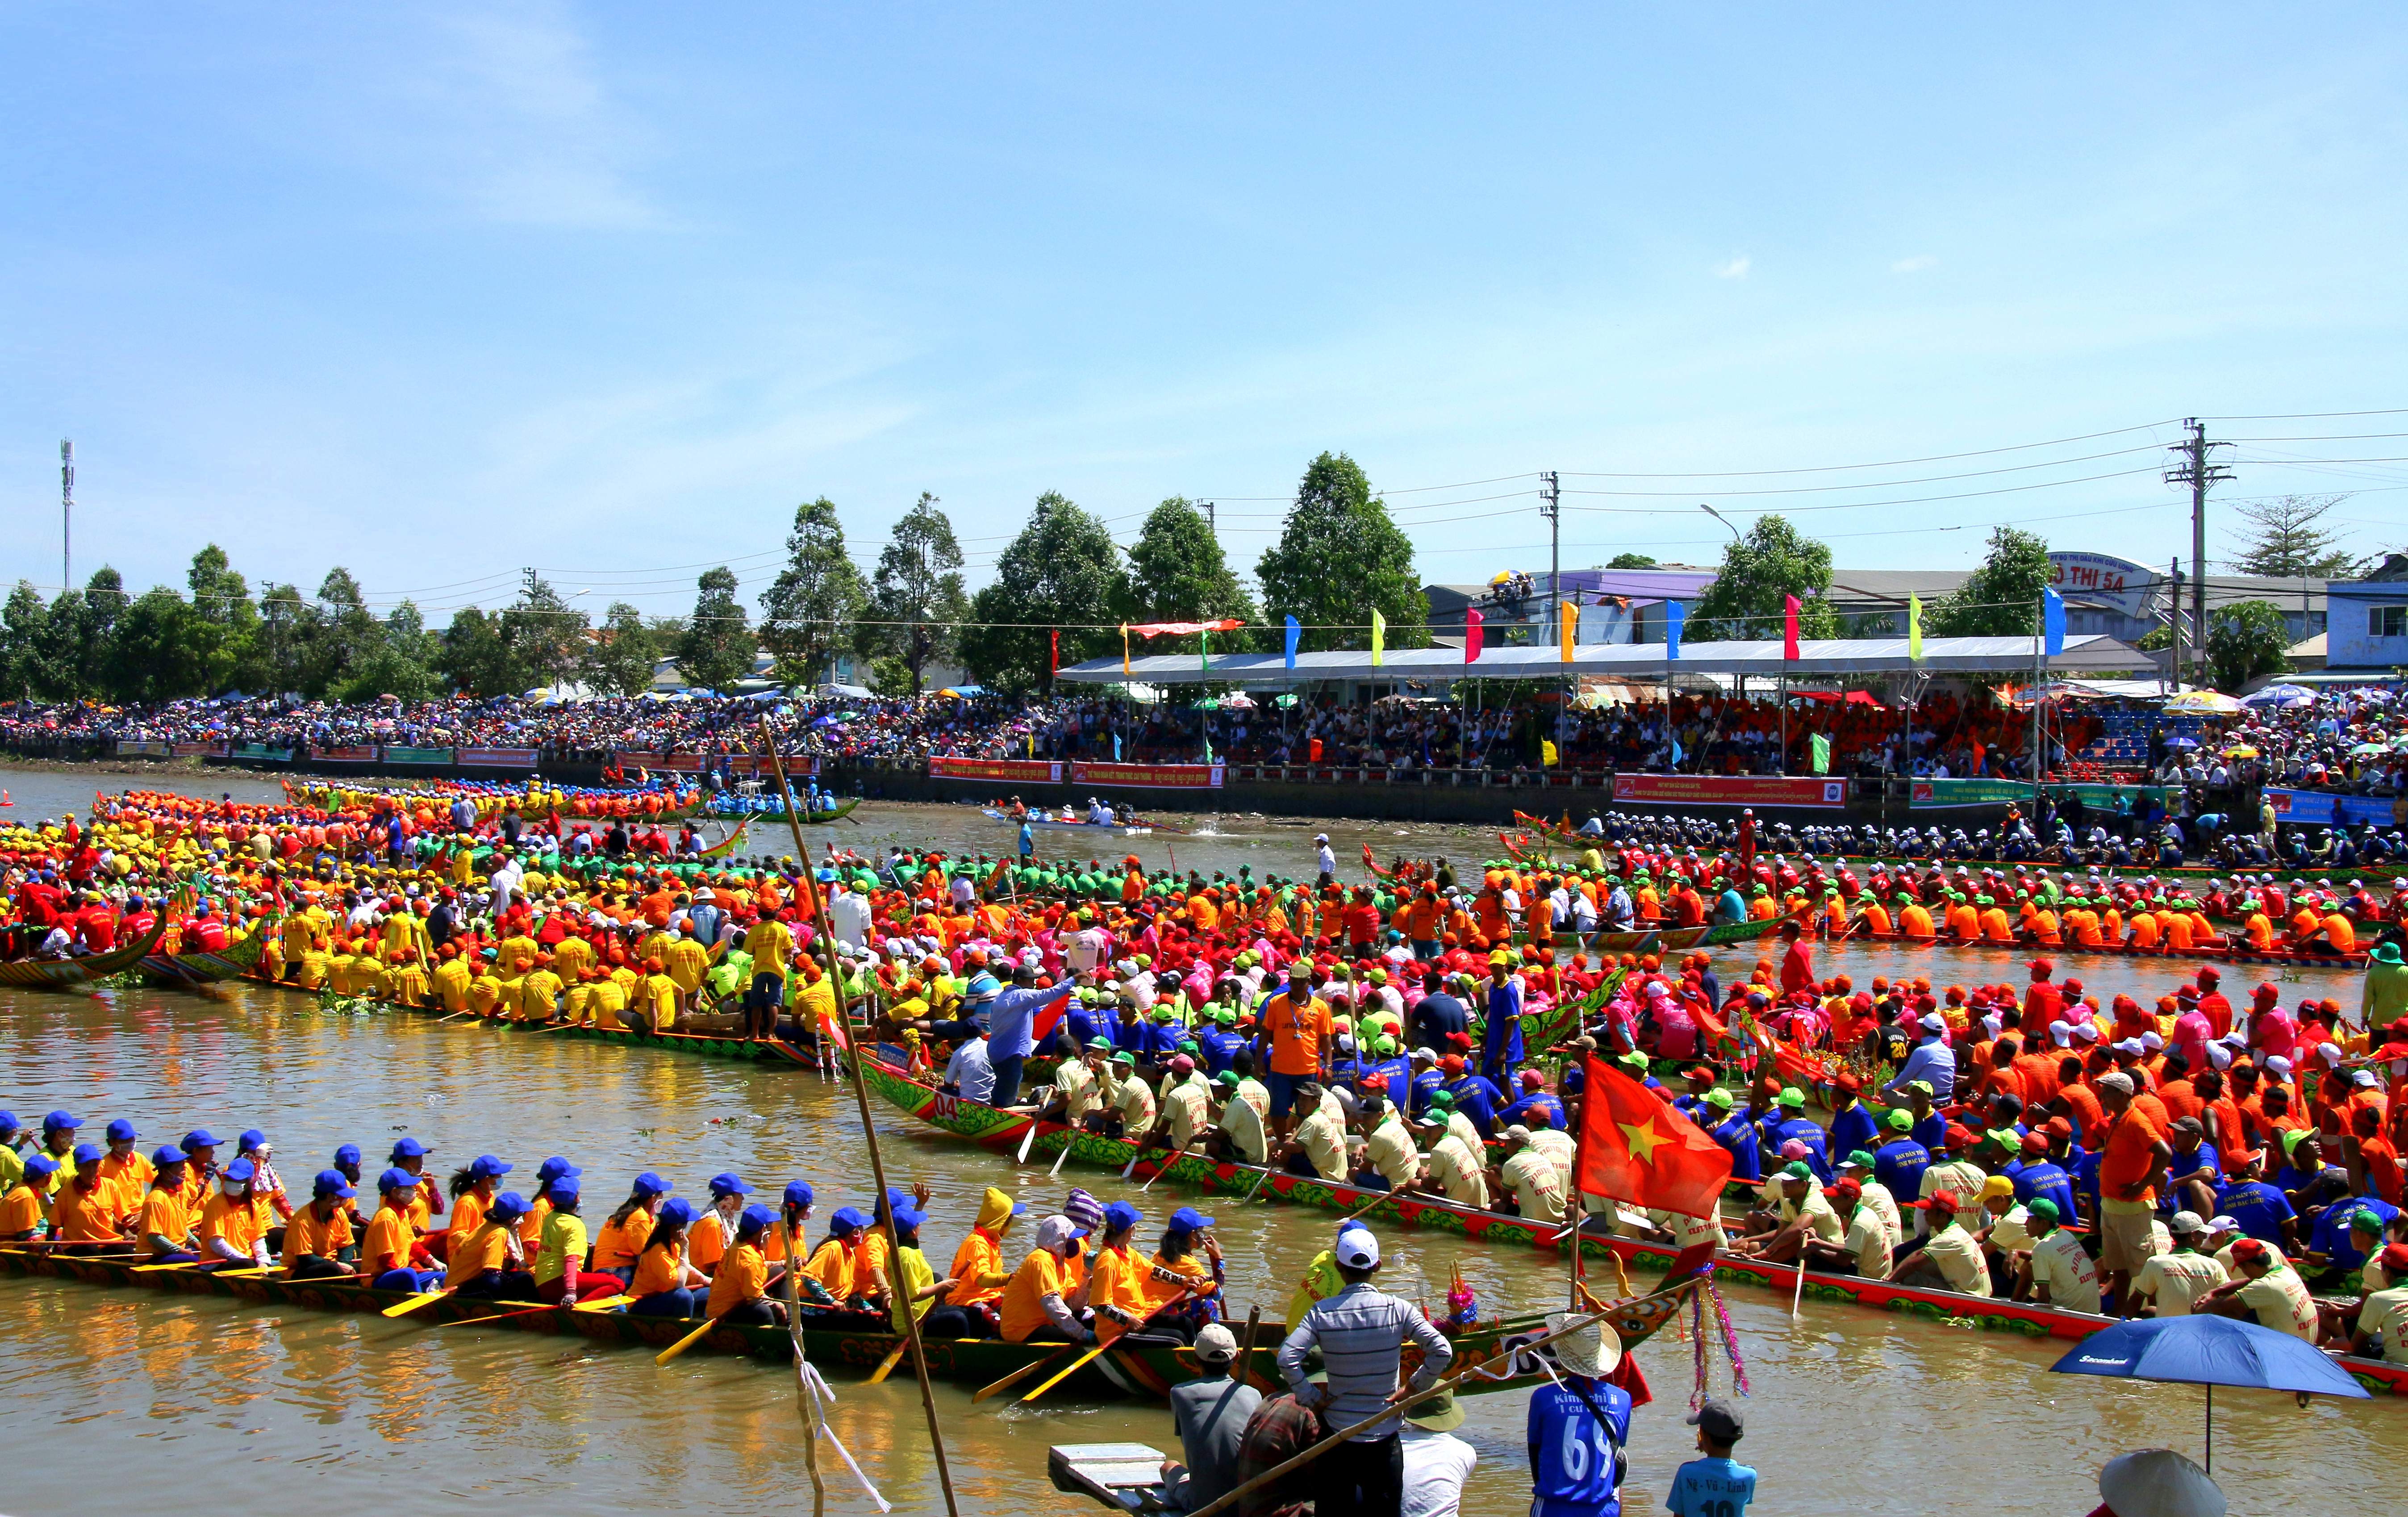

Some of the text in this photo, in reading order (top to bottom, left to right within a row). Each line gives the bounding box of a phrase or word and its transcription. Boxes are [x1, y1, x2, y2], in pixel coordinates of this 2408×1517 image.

[2118, 562, 2134, 573] LONG
[2070, 566, 2099, 590] THỊ
[1890, 1042, 1907, 1057] 20
[933, 1092, 959, 1121] 04
[2078, 1355, 2129, 1365] Sacombank
[1562, 1415, 1617, 1481] 69
[1727, 1481, 1746, 1492] Linh
